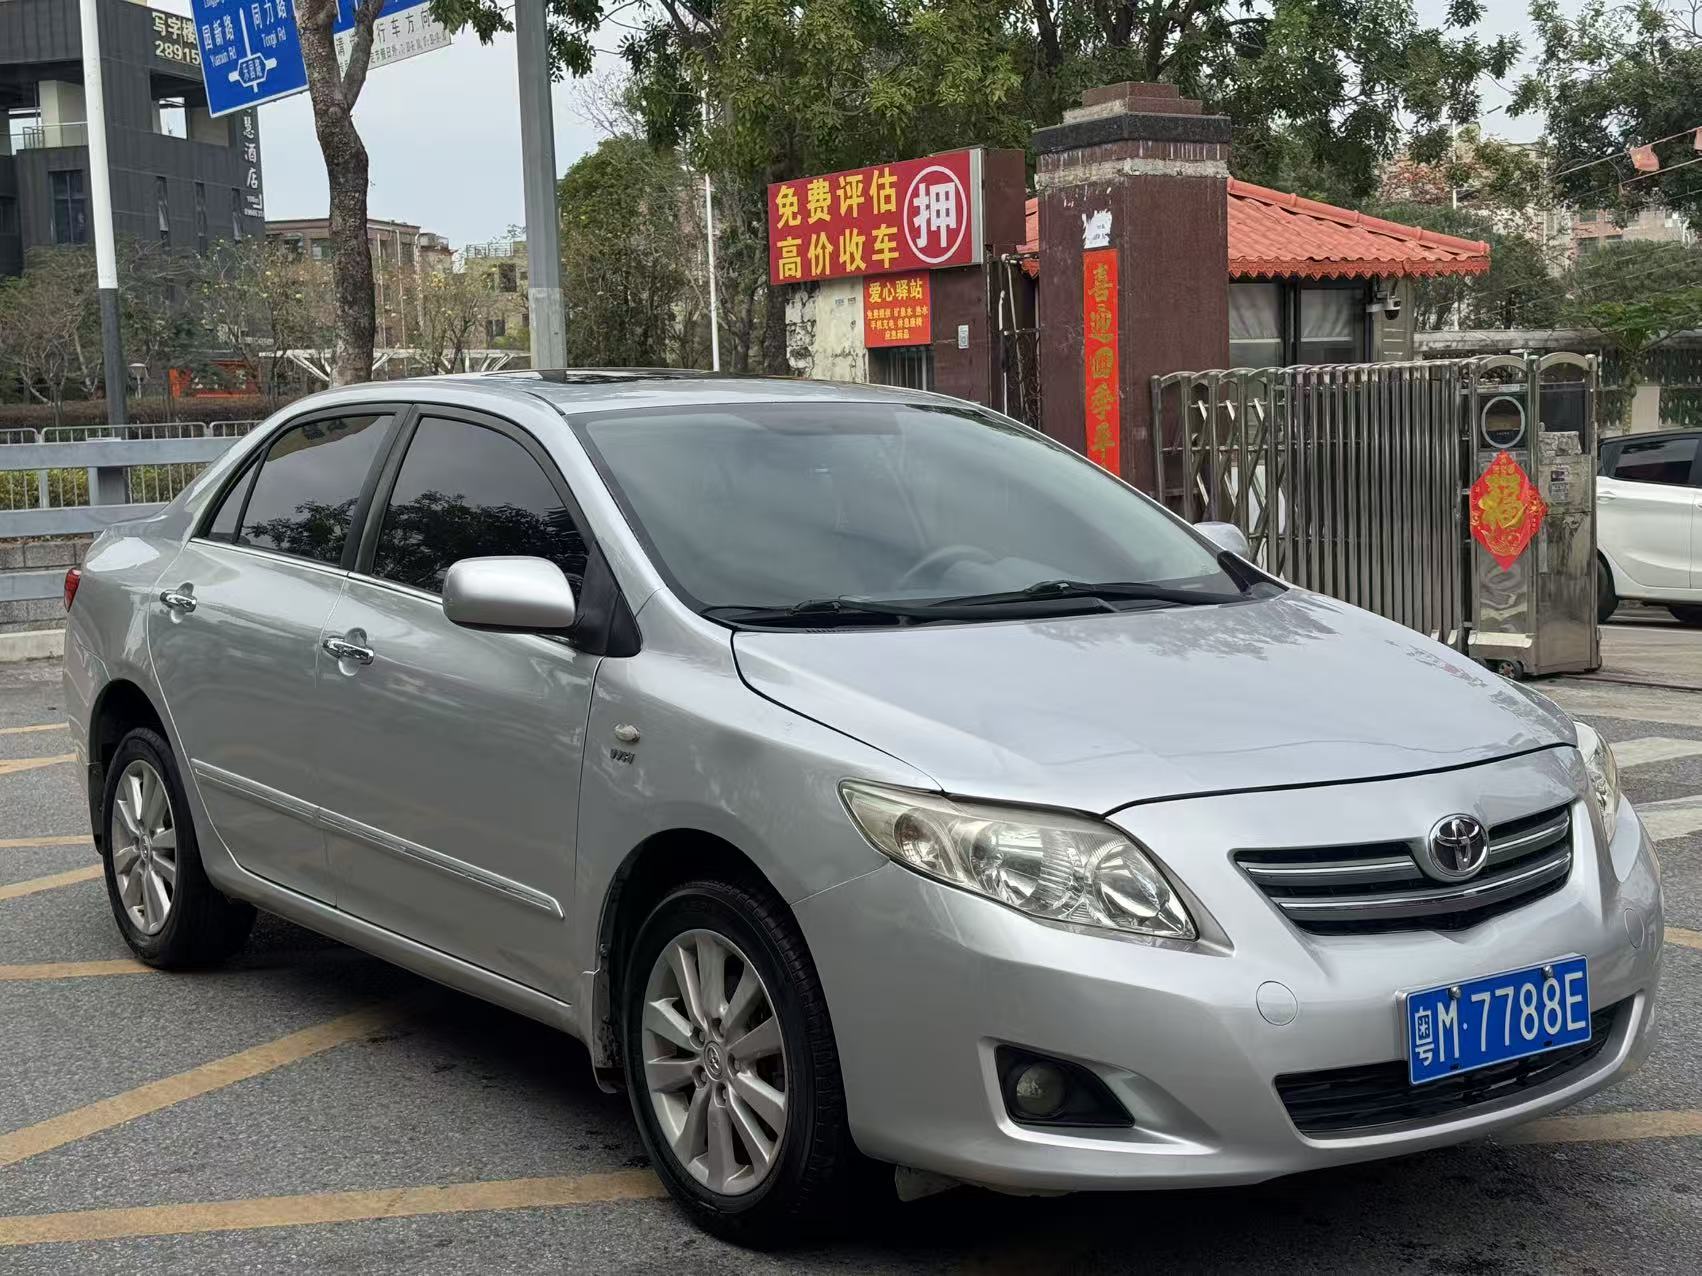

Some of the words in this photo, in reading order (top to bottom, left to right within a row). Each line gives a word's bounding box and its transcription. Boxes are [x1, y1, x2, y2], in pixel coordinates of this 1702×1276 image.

[152, 11, 198, 45] 写字楼
[202, 14, 235, 50] 园新路
[251, 0, 288, 30] 同力路
[154, 40, 200, 65] 28915
[243, 108, 258, 189] 慧酒店
[775, 167, 898, 230] 免费评估
[913, 181, 957, 249] 押
[776, 223, 900, 280] 高价收车
[869, 279, 923, 303] 爱心驿站
